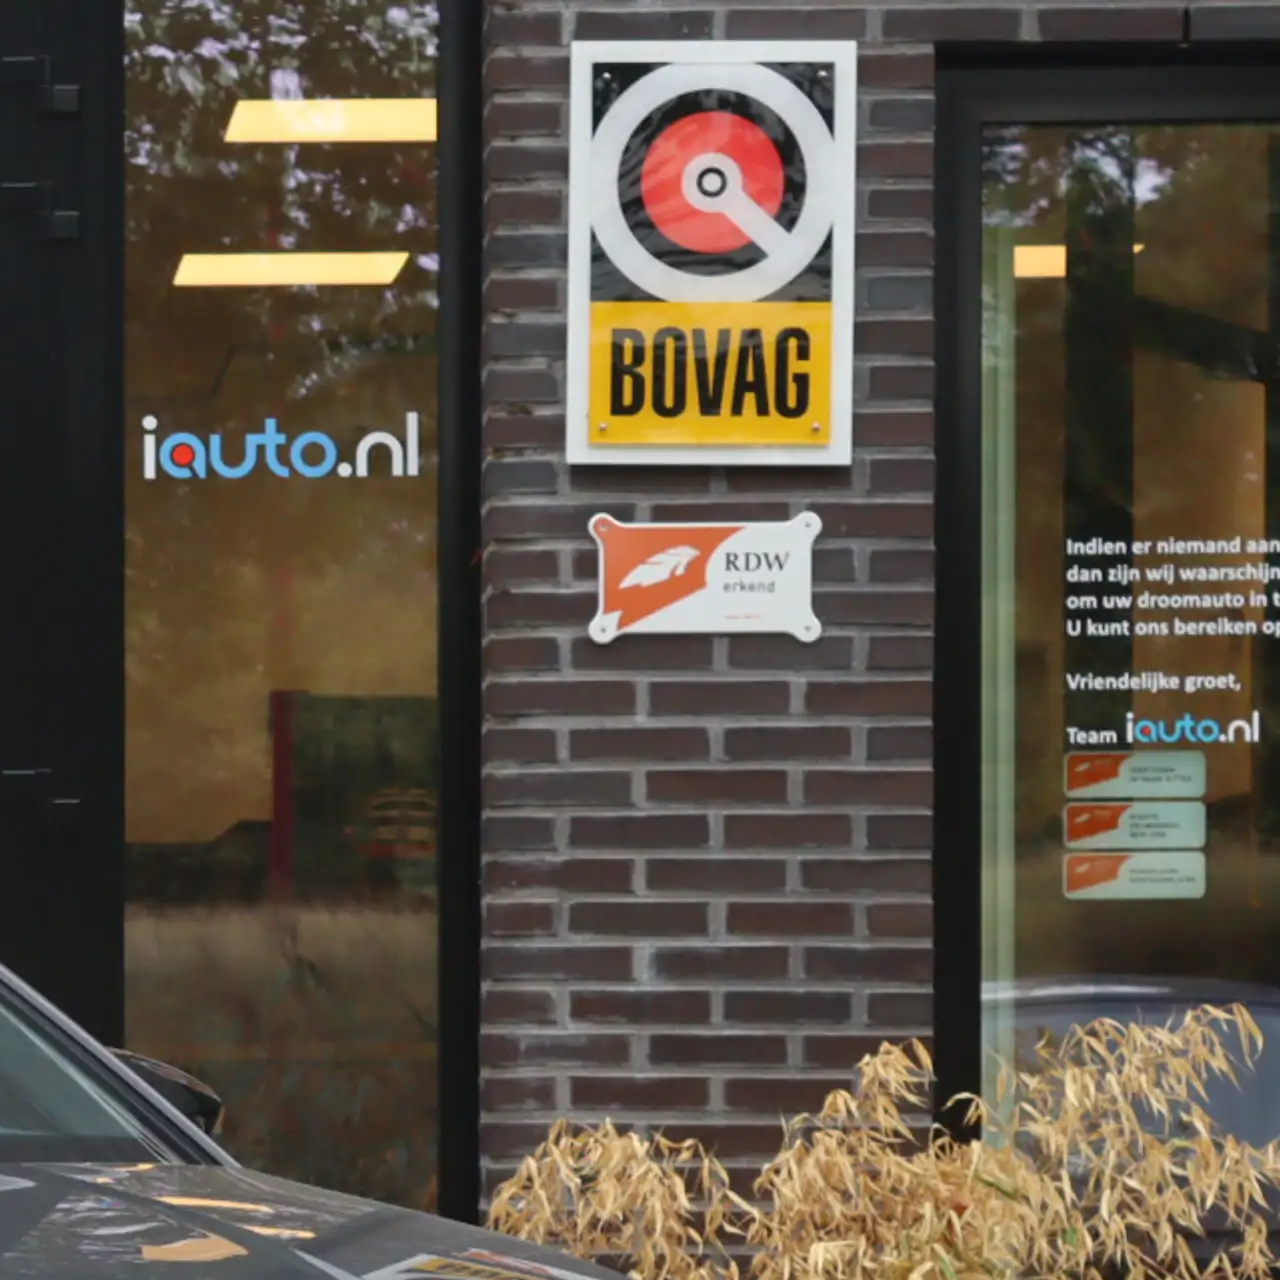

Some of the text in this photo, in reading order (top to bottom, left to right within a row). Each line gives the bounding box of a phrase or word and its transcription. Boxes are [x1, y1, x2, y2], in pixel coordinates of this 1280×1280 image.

[610, 327, 811, 418] BOVAG
[141, 411, 419, 479] iauto.nl
[1066, 537, 1127, 555] Indien
[1132, 539, 1152, 554] er
[1157, 536, 1241, 554] niemand
[723, 550, 791, 573] RDW
[1066, 565, 1103, 583] dan
[1108, 563, 1141, 586] zijn
[1145, 564, 1175, 585] wij
[722, 579, 776, 594] erkend
[1066, 595, 1098, 609] om
[1102, 594, 1133, 609] uw
[1137, 590, 1246, 609] droomauto
[1249, 591, 1268, 607] in
[1066, 619, 1082, 636] U
[1087, 618, 1130, 636] kunt
[1134, 620, 1170, 635] ons
[1174, 616, 1257, 635] bereiken
[1066, 671, 1242, 694] Vriendelijke groet,
[1066, 709, 1260, 744] Team iauto.nl
